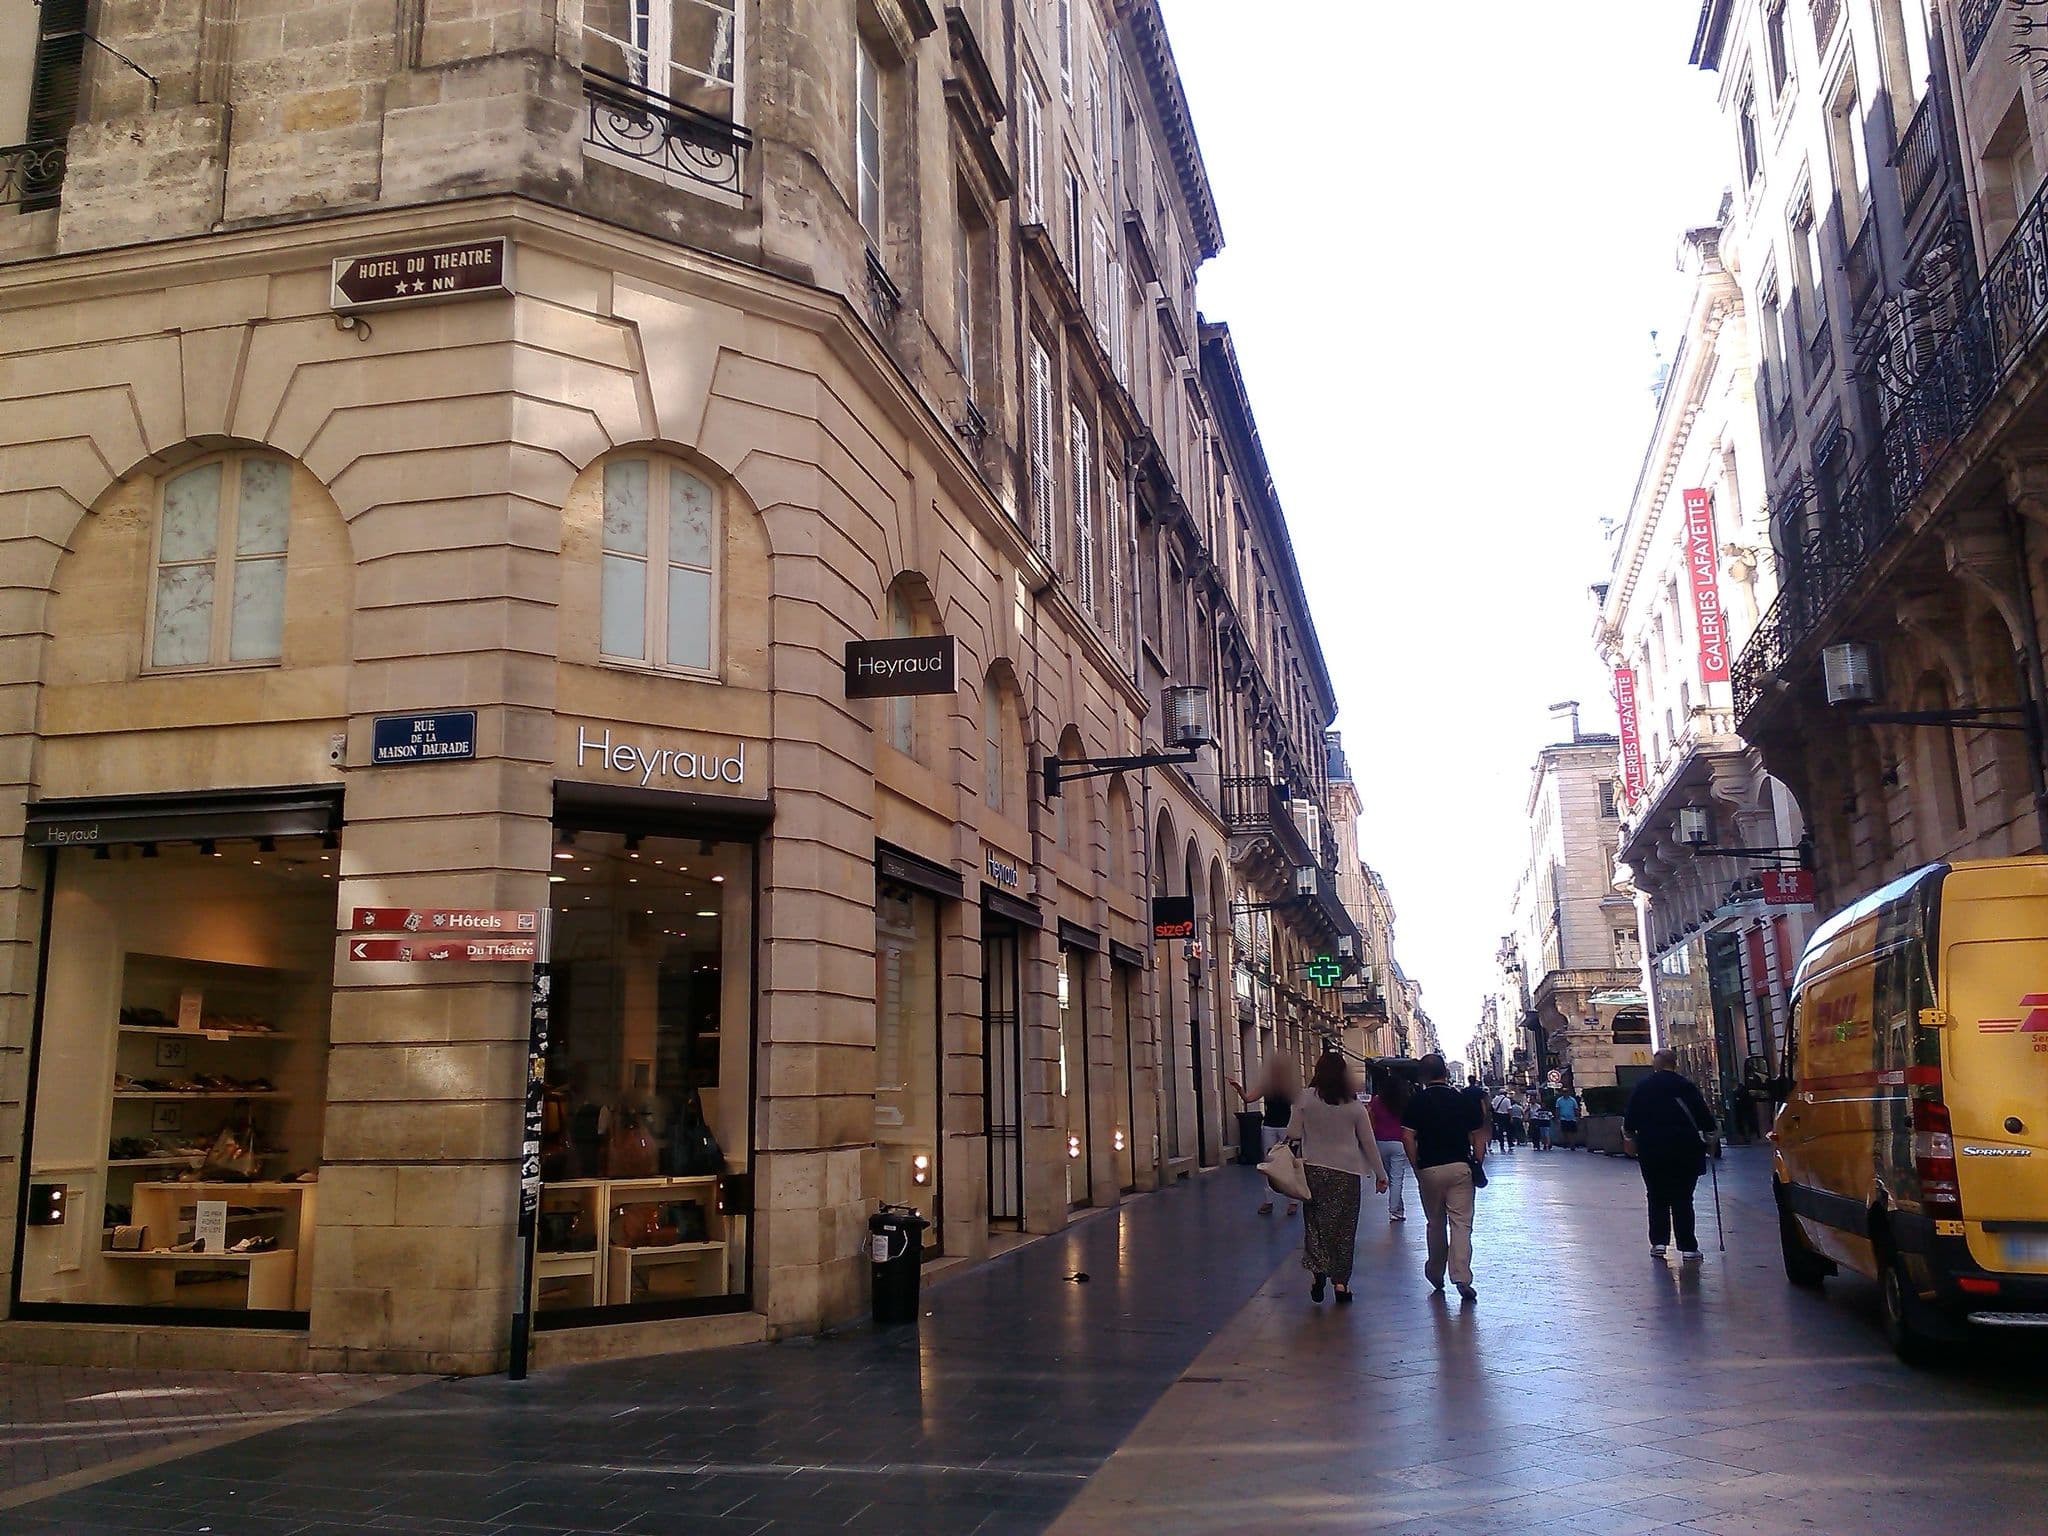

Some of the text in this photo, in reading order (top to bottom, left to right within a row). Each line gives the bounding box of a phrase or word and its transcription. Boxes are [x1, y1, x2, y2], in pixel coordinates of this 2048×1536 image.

[359, 248, 493, 279] HOTEL DU THEATRE
[432, 276, 455, 291] NN
[1688, 497, 1724, 672] GALERIES LAFAYETTE
[857, 650, 942, 678] Heyraud
[413, 719, 436, 732] RUE
[411, 732, 437, 744] DE LA
[1618, 676, 1642, 799] GALERIES LAFAYETTE
[378, 741, 469, 759] MAISON DAURADE
[577, 725, 745, 787] Heyraud
[48, 824, 99, 845] Heyraud
[449, 913, 502, 929] Hôtels
[1155, 921, 1193, 937] size?
[467, 944, 534, 956] Du Théâtre
